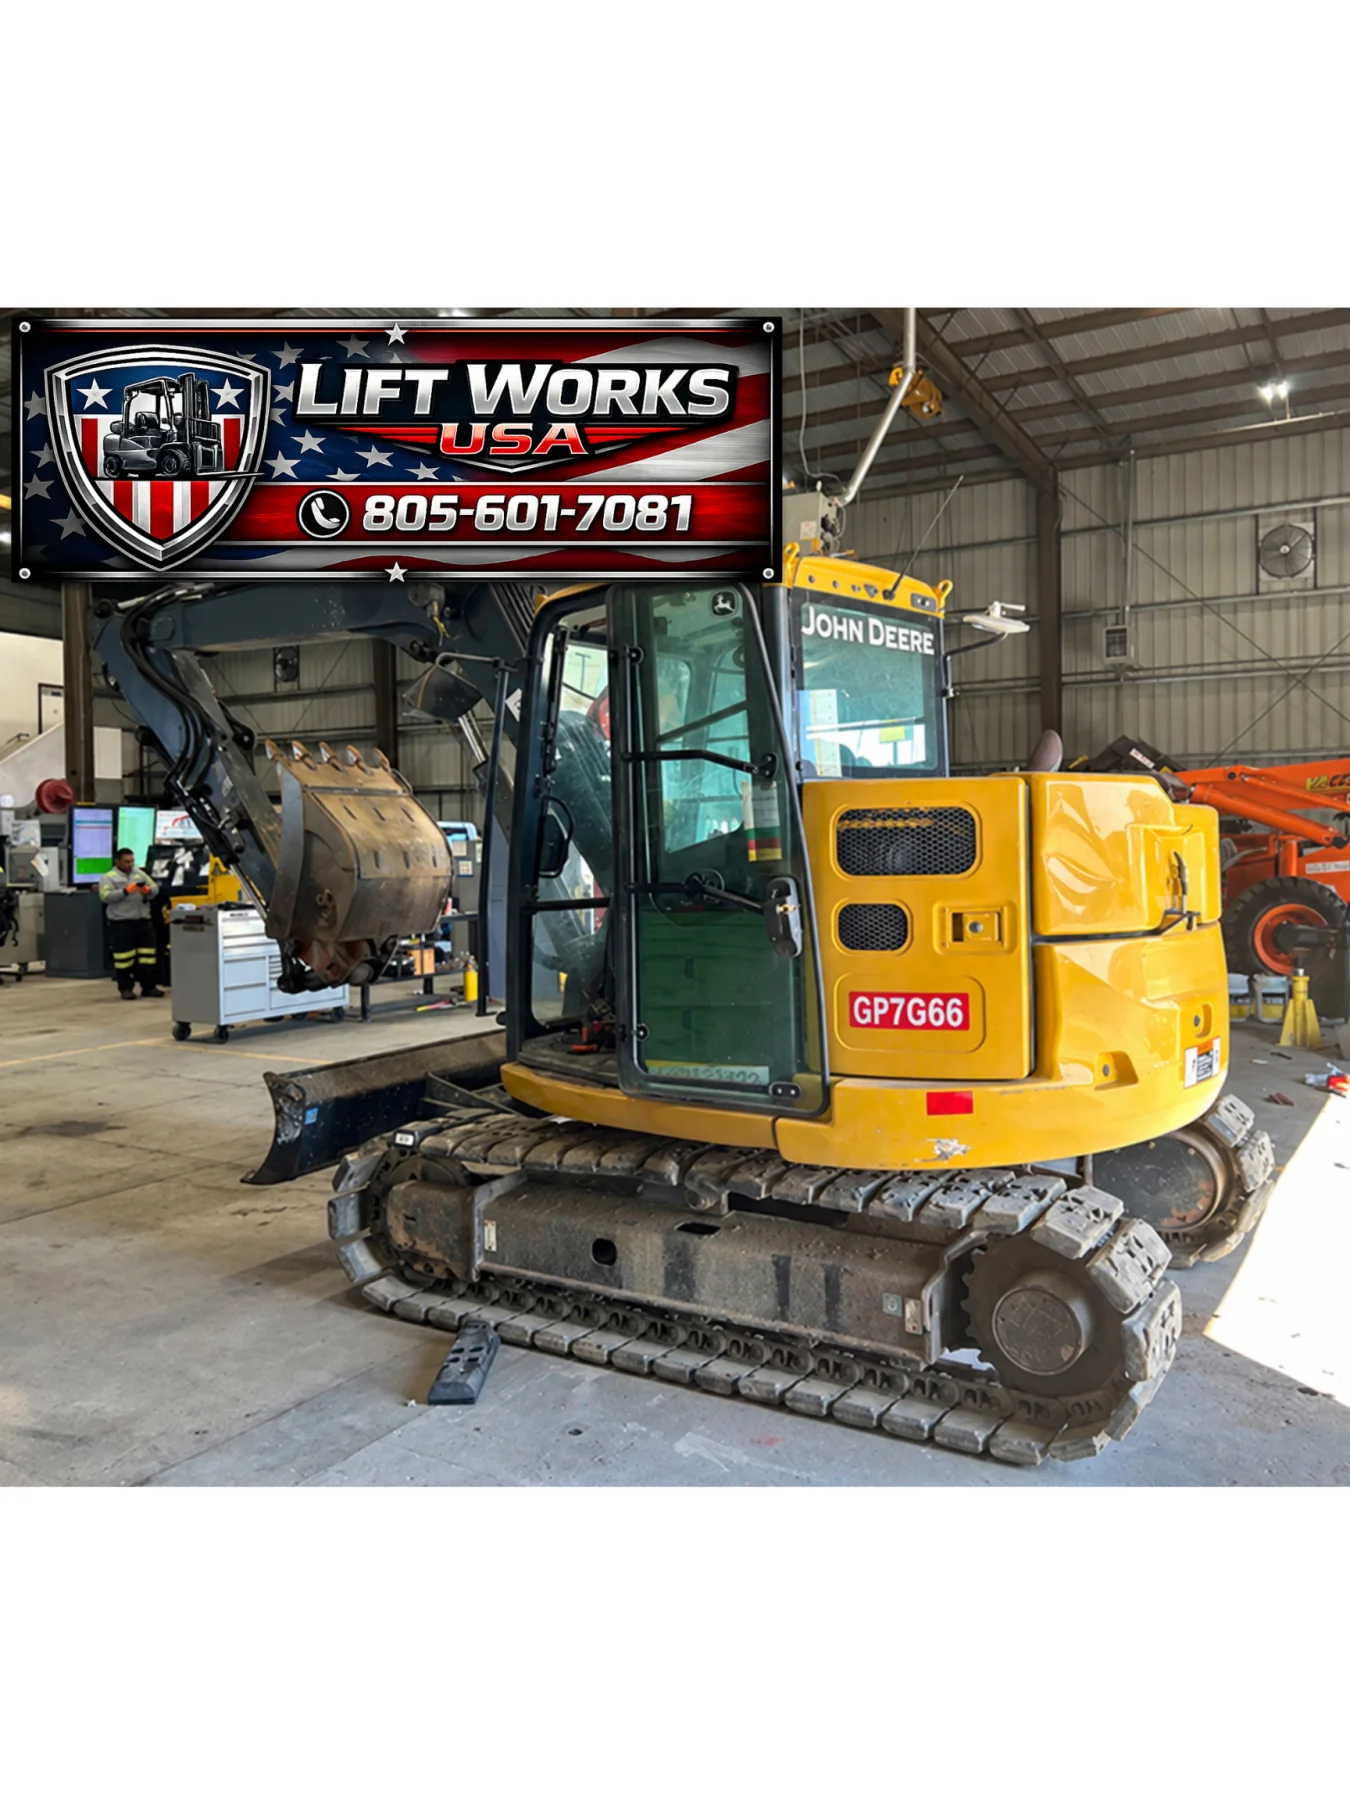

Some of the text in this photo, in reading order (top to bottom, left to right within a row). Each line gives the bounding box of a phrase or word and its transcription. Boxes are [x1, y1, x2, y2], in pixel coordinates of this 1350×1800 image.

[801, 606, 935, 655] JOHN DEERE
[853, 996, 964, 1027] GP7G66
